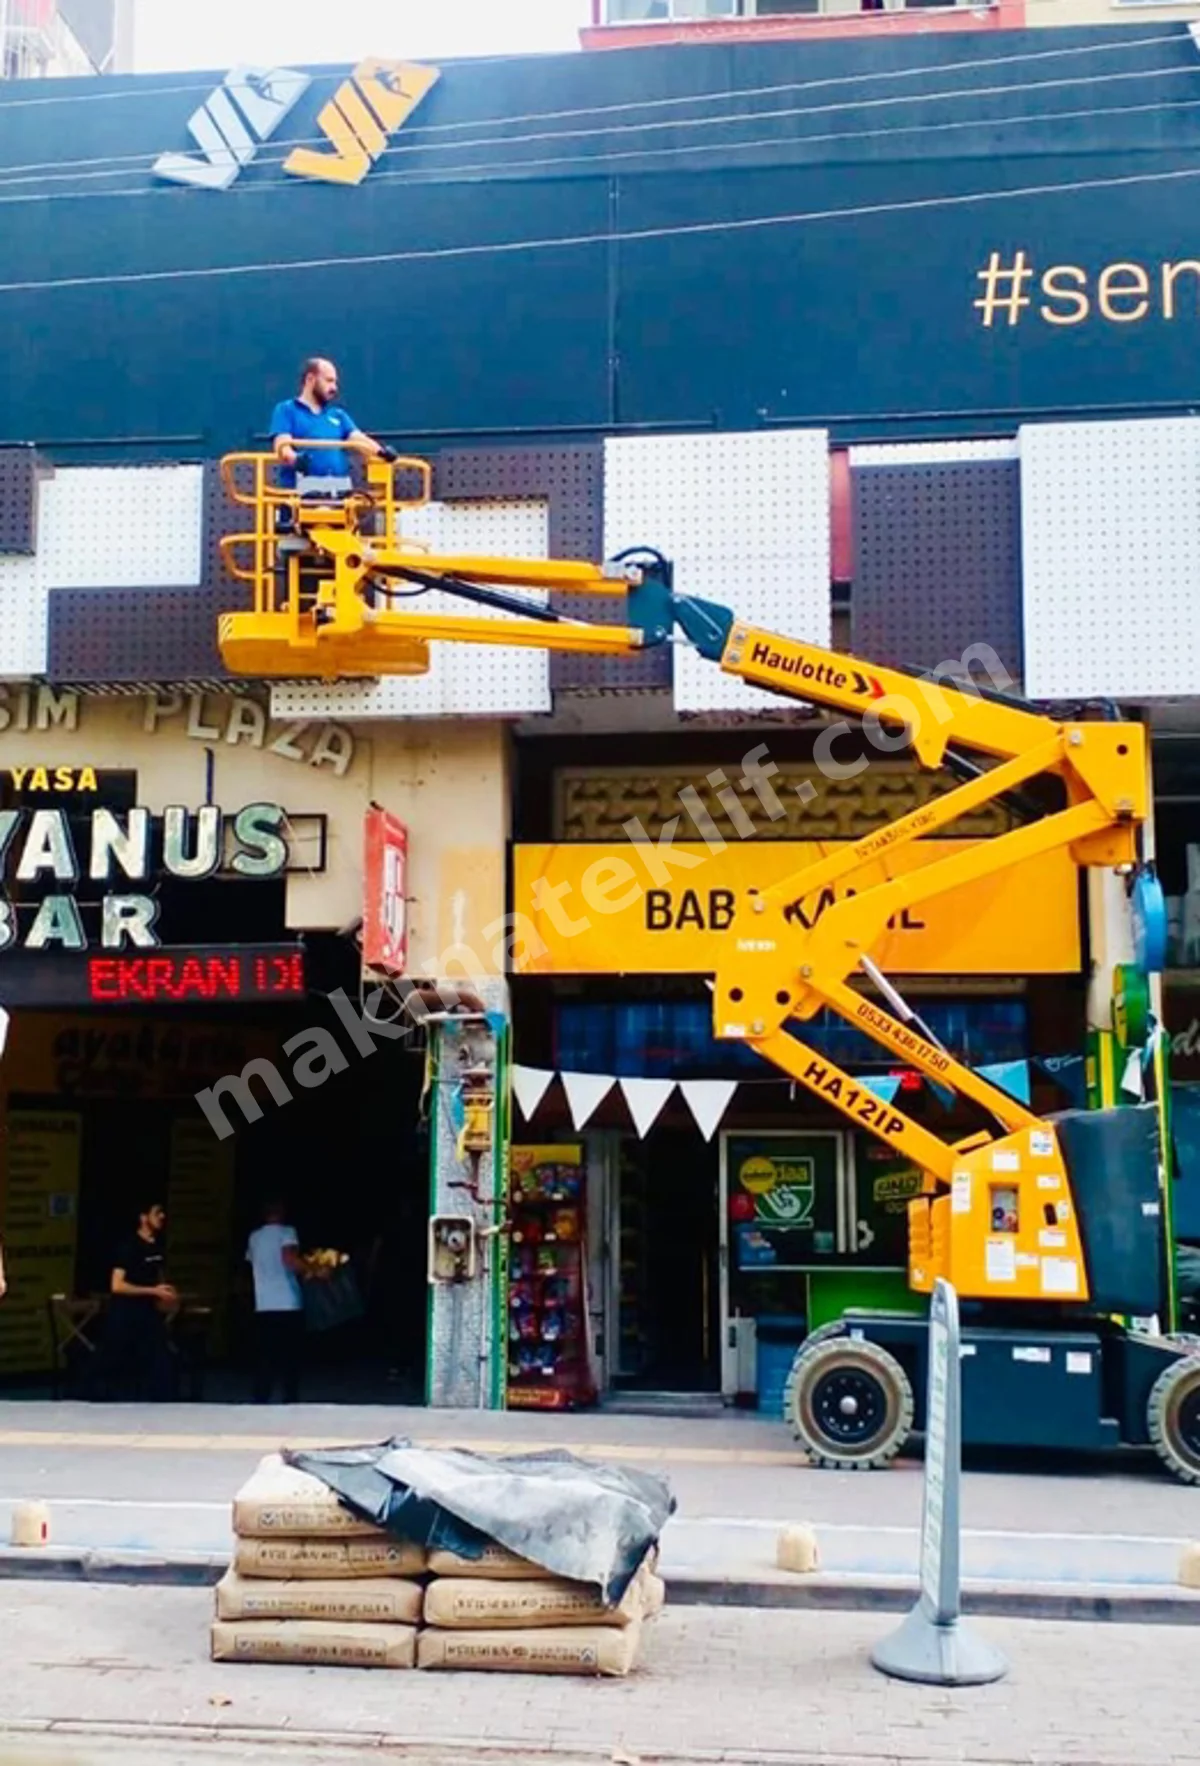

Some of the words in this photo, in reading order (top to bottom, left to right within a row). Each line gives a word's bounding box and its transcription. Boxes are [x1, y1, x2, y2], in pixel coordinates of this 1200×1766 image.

[750, 642, 848, 689] Haulotte
[142, 692, 353, 777] PLAZA
[10, 766, 99, 792] YASA
[88, 957, 240, 1001] EKRAN
[857, 1002, 891, 1033] 0533
[803, 1061, 904, 1135] HA12IP
